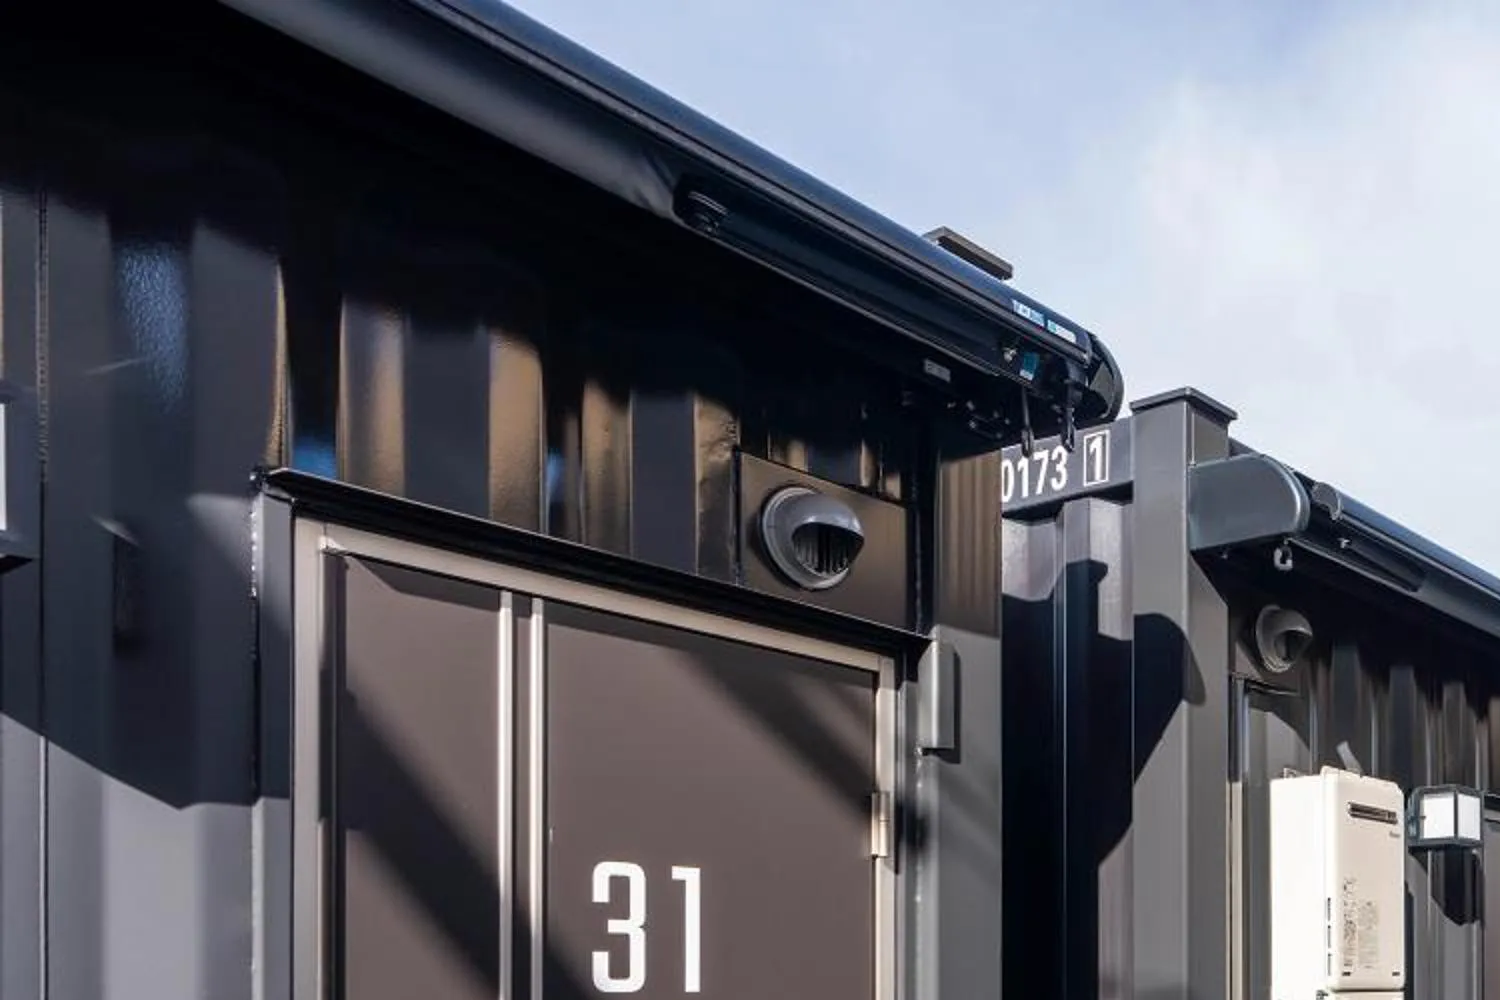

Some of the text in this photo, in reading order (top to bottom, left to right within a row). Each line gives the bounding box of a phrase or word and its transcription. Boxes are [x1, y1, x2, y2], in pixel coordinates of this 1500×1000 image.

[1001, 433, 1104, 502] 0173 1
[592, 861, 701, 993] 31
